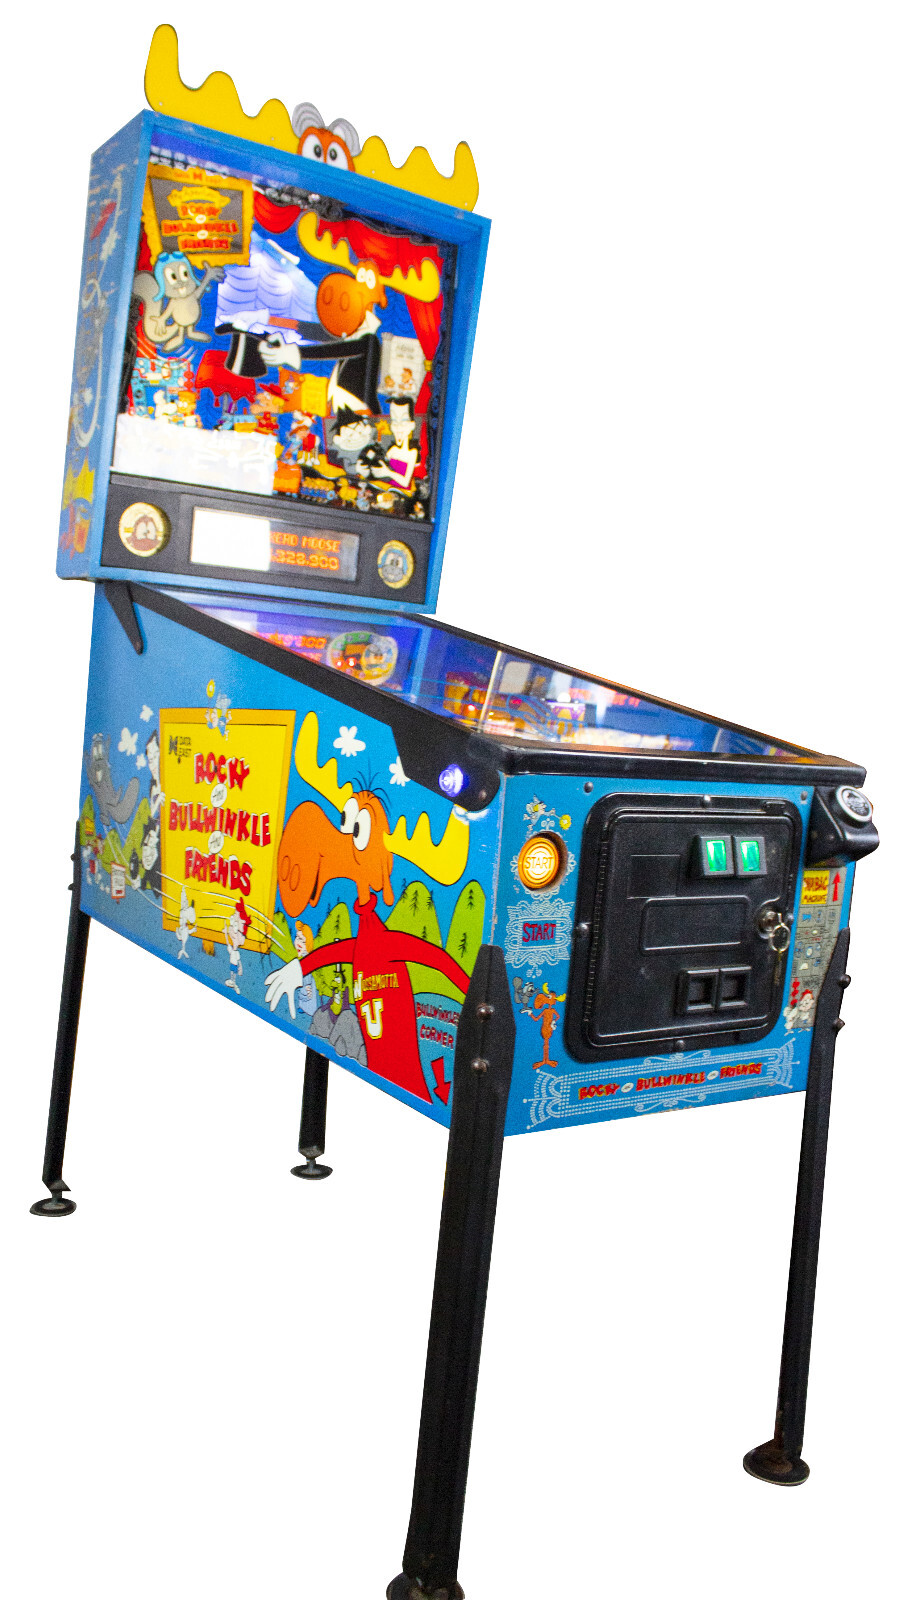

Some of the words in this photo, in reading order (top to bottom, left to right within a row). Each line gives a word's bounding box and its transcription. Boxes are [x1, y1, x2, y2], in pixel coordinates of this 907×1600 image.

[302, 536, 341, 553] MOOSE
[194, 752, 250, 790] ROCKY
[168, 798, 271, 847] BULLWINKLE
[185, 846, 253, 896] FRIENDS
[524, 856, 554, 871] START
[522, 922, 557, 942] START
[360, 998, 384, 1040] U
[420, 1024, 454, 1051] CORNER
[578, 1083, 620, 1101] ROCKY
[636, 1071, 706, 1092] BULLWINKLE
[719, 1062, 763, 1079] FRIENDS
